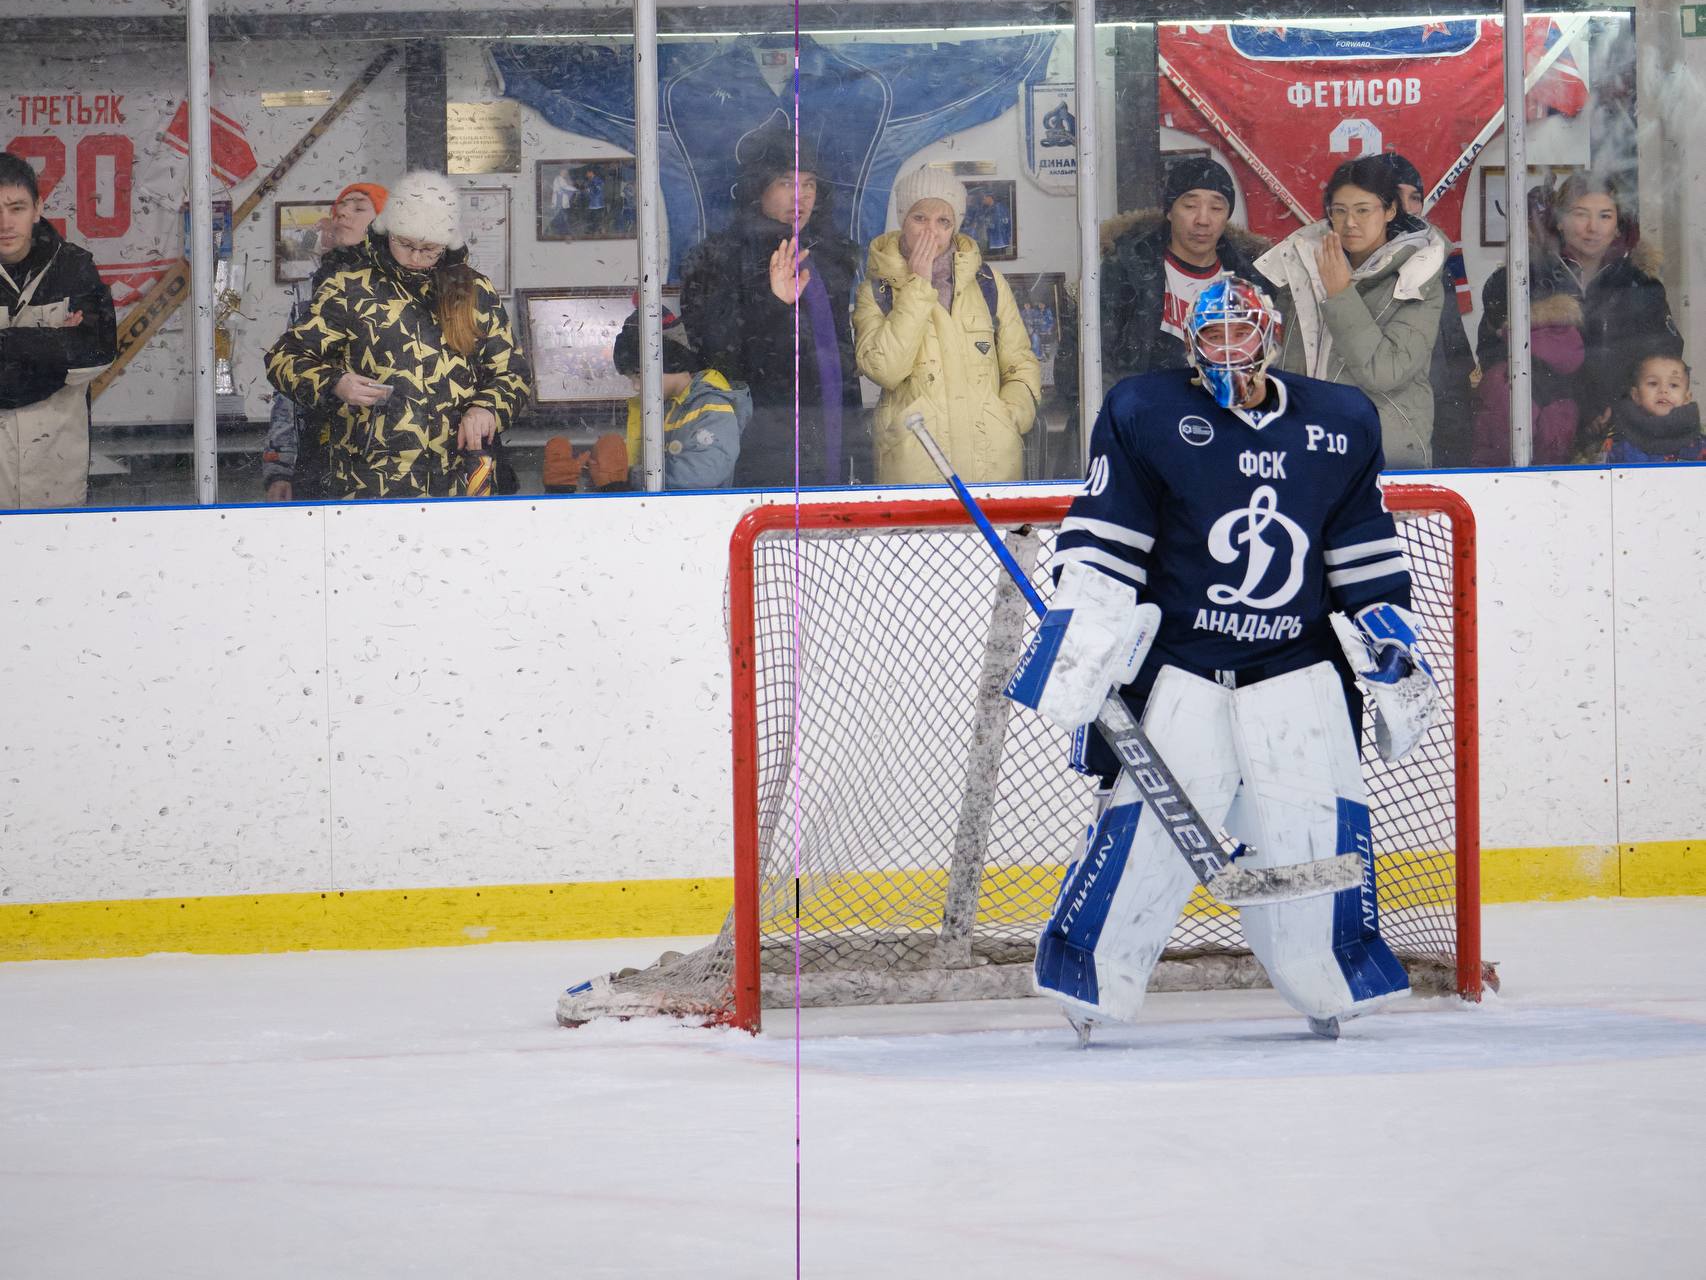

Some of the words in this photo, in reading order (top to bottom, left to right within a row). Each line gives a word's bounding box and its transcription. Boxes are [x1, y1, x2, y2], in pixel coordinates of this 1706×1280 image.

[1336, 40, 1371, 48] FORWARD
[1166, 65, 1231, 139] TITAN
[1287, 78, 1421, 108] ФЕТИСОВ
[18, 95, 126, 127] ТРЕТЬЯК
[1040, 158, 1077, 168] ДИНАМ
[1428, 143, 1482, 201] TACKLA
[6, 135, 134, 238] 20
[1238, 450, 1287, 480] ФСК
[1192, 608, 1303, 641] АНАДЫРЬ
